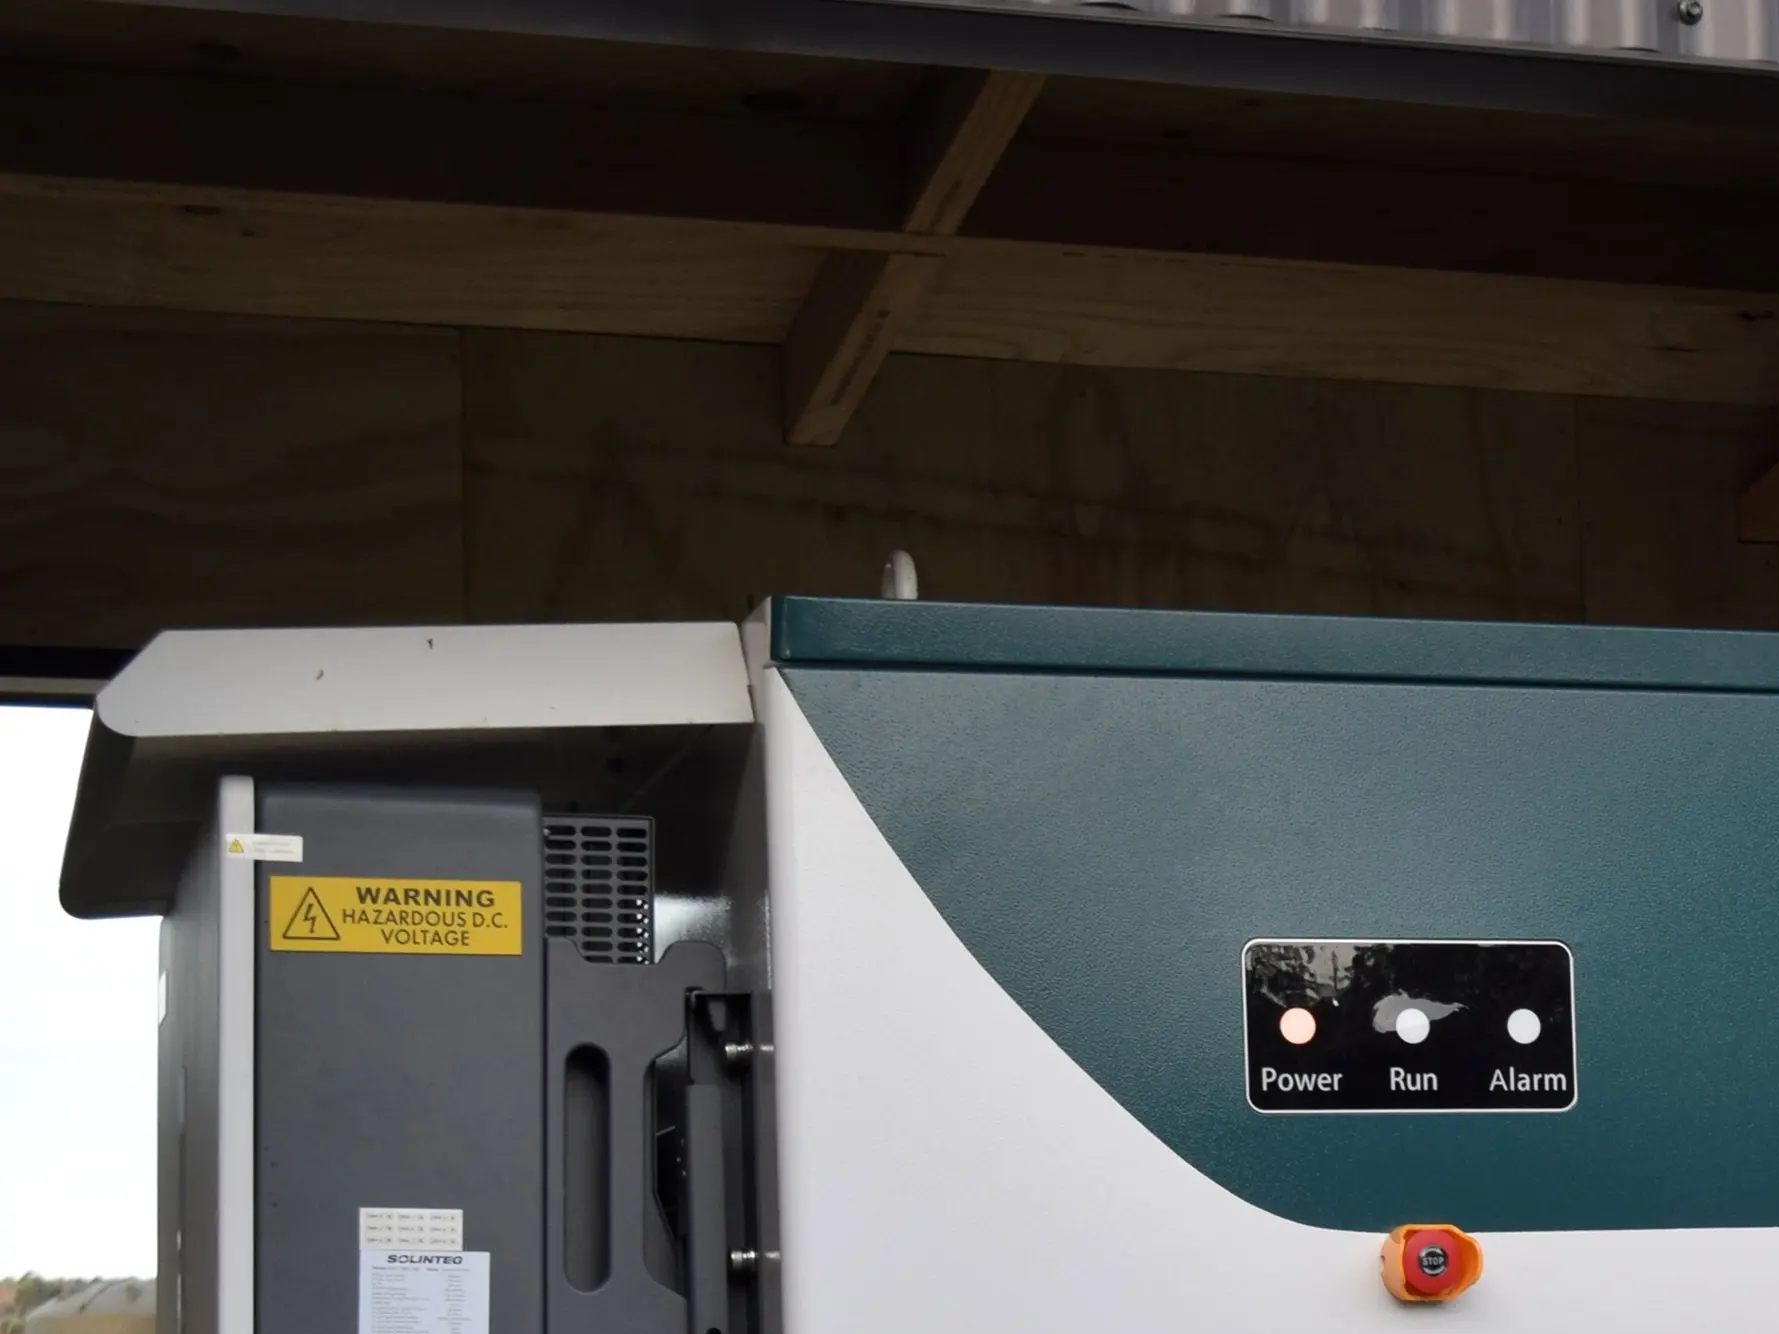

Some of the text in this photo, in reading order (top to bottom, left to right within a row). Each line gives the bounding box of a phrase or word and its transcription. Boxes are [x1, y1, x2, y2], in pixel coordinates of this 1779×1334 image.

[355, 886, 495, 908] WARNING
[342, 908, 509, 929] HAZARDOUS D.C.
[381, 928, 470, 947] VOLTAGE
[1261, 1067, 1343, 1091] Power
[1390, 1067, 1438, 1091] Run
[1489, 1067, 1567, 1091] Alarm
[387, 1254, 463, 1265] SOLINTEG
[1422, 1256, 1444, 1266] STOP
